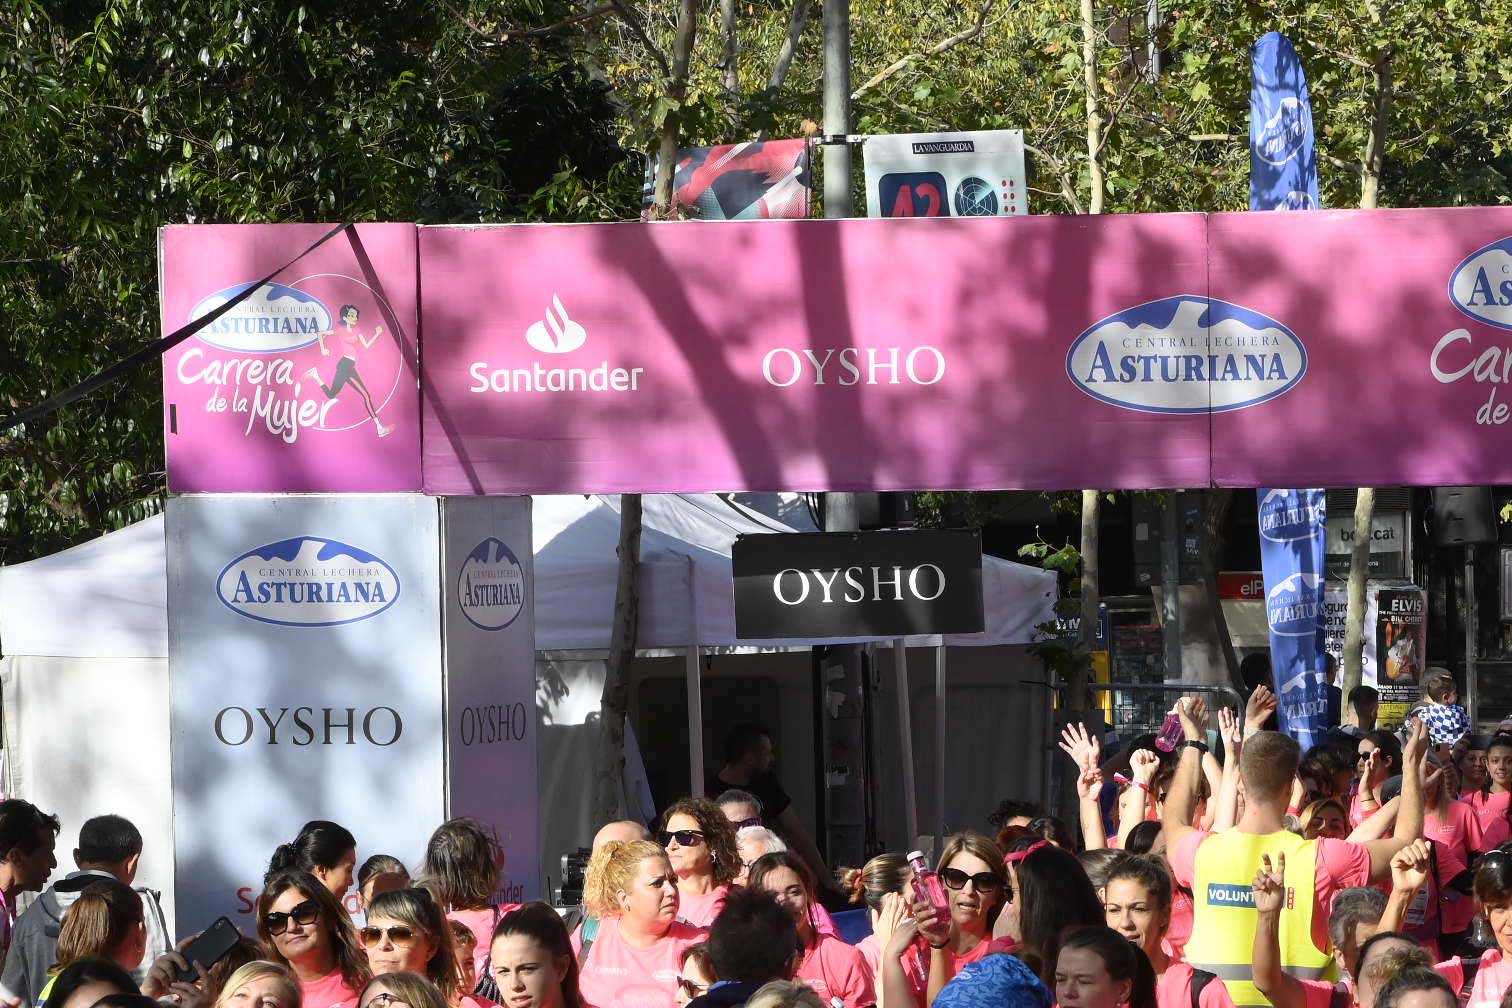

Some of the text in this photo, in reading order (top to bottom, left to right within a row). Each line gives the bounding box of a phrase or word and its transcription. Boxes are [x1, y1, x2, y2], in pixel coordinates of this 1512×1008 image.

[1122, 335, 1280, 348] CENTRAL LECHERA
[176, 347, 294, 385] Carrera
[469, 363, 644, 393] Santander
[762, 345, 946, 387] OYSHO
[1085, 339, 1288, 384] ASTURIANA
[206, 382, 339, 444] de la Mujer
[1475, 386, 1511, 426] de
[231, 570, 387, 604] ASTURIANA
[258, 567, 381, 577] CENTRAL LECHERA
[463, 573, 521, 608] ASTURIANA
[772, 562, 947, 606] OYSHO
[1391, 599, 1422, 612] ELVIS
[214, 705, 403, 747] OYSHO
[460, 702, 527, 746] OYSHO
